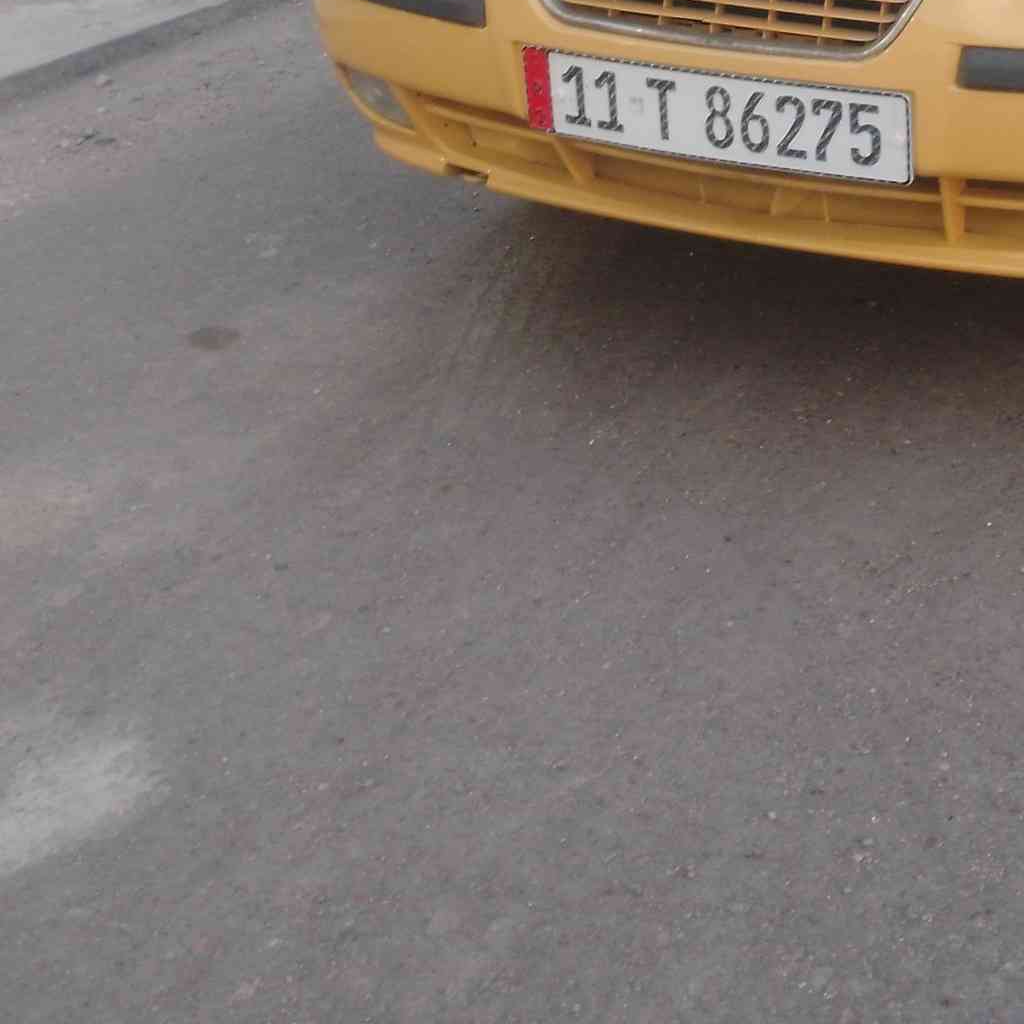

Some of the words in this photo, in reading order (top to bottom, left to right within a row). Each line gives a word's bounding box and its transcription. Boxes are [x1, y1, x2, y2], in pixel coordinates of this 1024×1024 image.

[561, 64, 625, 133] 11
[645, 77, 677, 141] T
[704, 85, 882, 168] 86275
